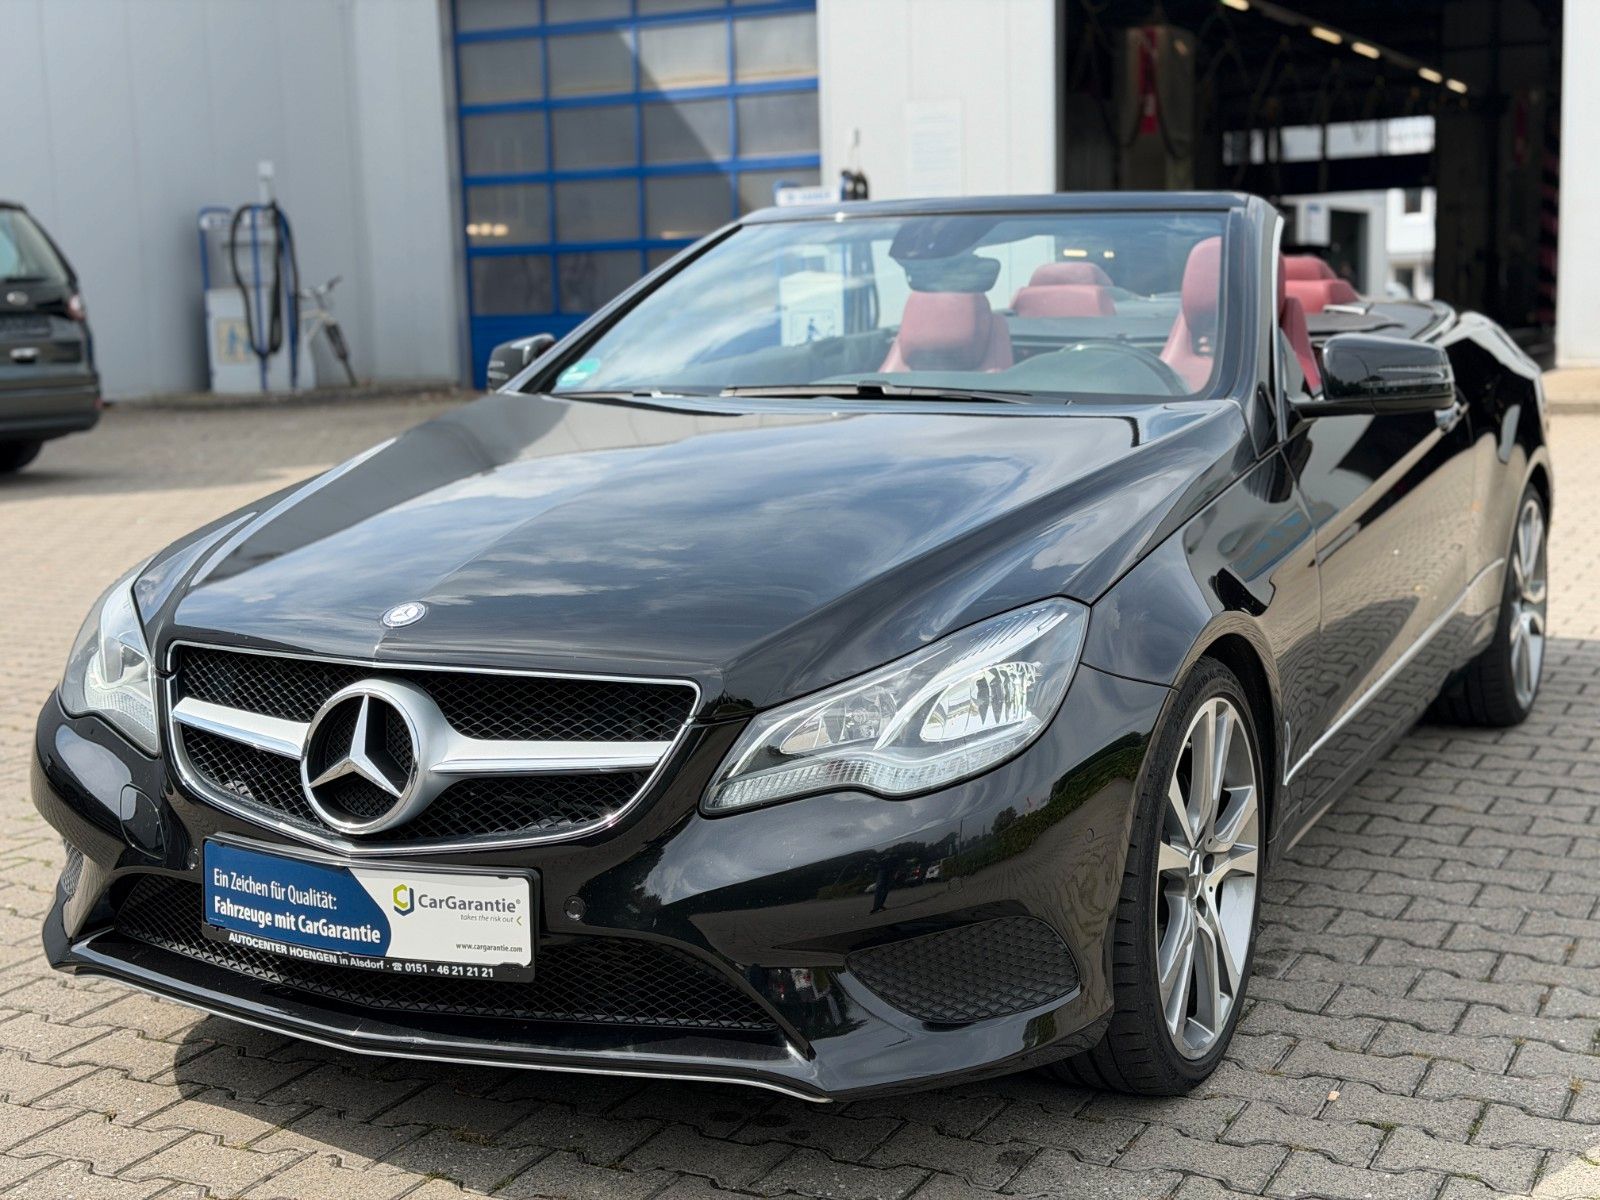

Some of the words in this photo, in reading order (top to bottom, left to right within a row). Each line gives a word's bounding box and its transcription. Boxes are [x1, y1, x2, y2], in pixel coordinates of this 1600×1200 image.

[213, 868, 228, 888] Ein
[231, 872, 268, 897] Zeichen
[270, 881, 285, 900] für
[288, 885, 337, 910] Qualität:
[214, 895, 272, 928] Fahrzeuge
[275, 912, 296, 931] mit
[298, 915, 380, 944] CarGarantie
[228, 932, 288, 955] AUTOCENTER
[289, 946, 338, 964] HOENGEN
[339, 956, 349, 966] in
[350, 958, 384, 970] Alsdorf
[405, 963, 428, 974] 0151
[437, 965, 450, 975] 46
[451, 967, 464, 976] 21
[466, 967, 479, 977] 21
[481, 968, 494, 977] 21
[456, 943, 523, 952] www.cargarantie.com
